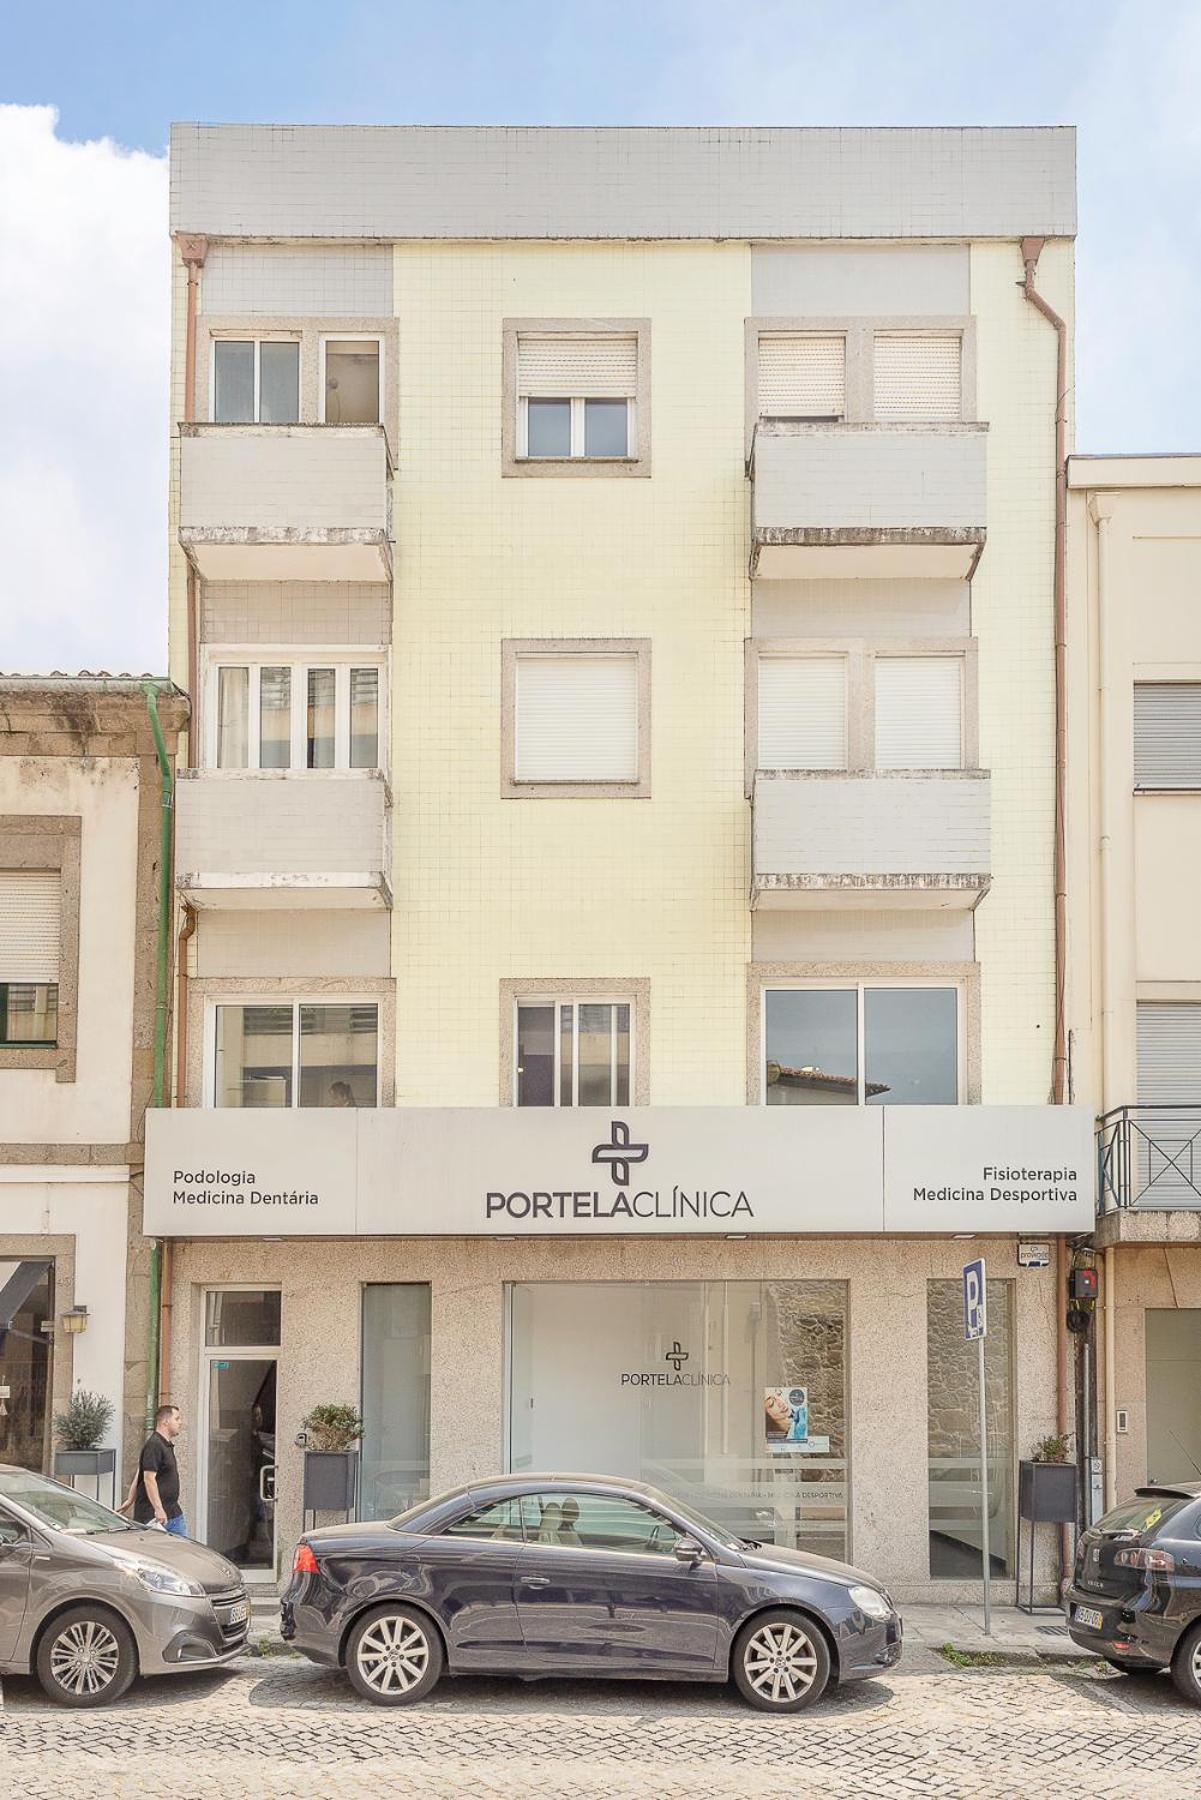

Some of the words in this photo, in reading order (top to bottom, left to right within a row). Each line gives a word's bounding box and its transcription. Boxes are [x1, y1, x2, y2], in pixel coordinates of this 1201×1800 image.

[173, 1170, 256, 1187] Podologia
[983, 1166, 1077, 1184] Fisioterapia
[173, 1190, 245, 1205] Medicina
[250, 1190, 319, 1205] Dentária
[486, 1185, 754, 1219] PORTELACLÍNICA
[913, 1187, 985, 1201] Medicina
[990, 1187, 1077, 1205] Desportiva
[620, 1371, 731, 1386] PORTELACLÍNICA
